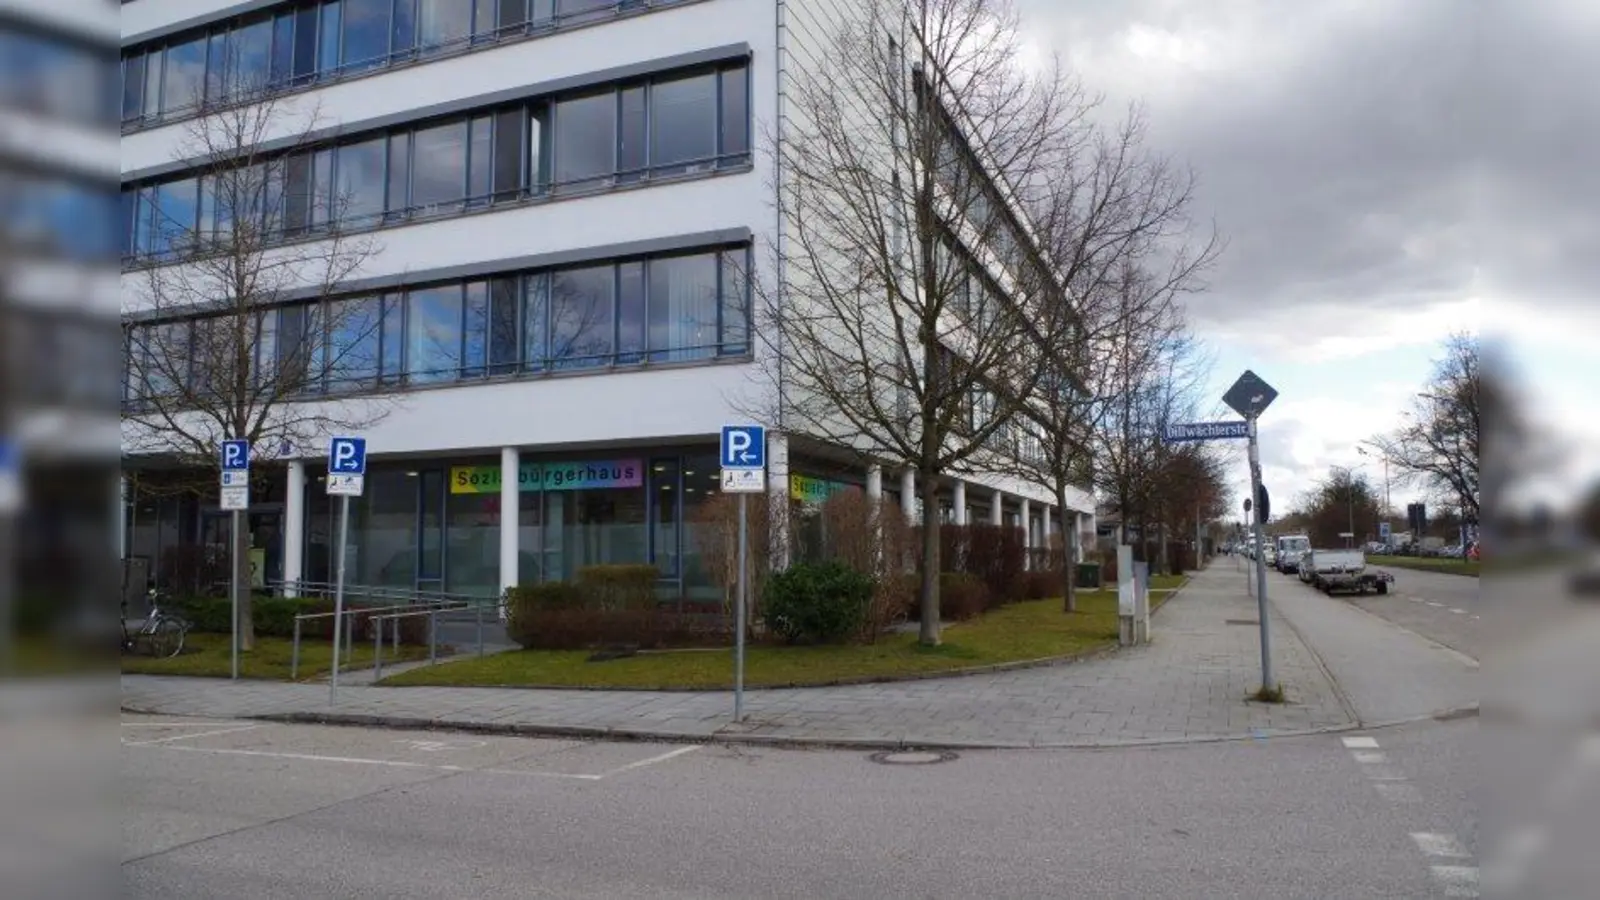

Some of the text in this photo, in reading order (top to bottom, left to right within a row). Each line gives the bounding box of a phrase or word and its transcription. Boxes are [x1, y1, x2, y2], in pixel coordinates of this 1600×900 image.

[225, 443, 240, 466] P
[335, 441, 355, 469] P
[728, 430, 751, 462] P
[457, 466, 635, 486] Sozibürgerhaus
